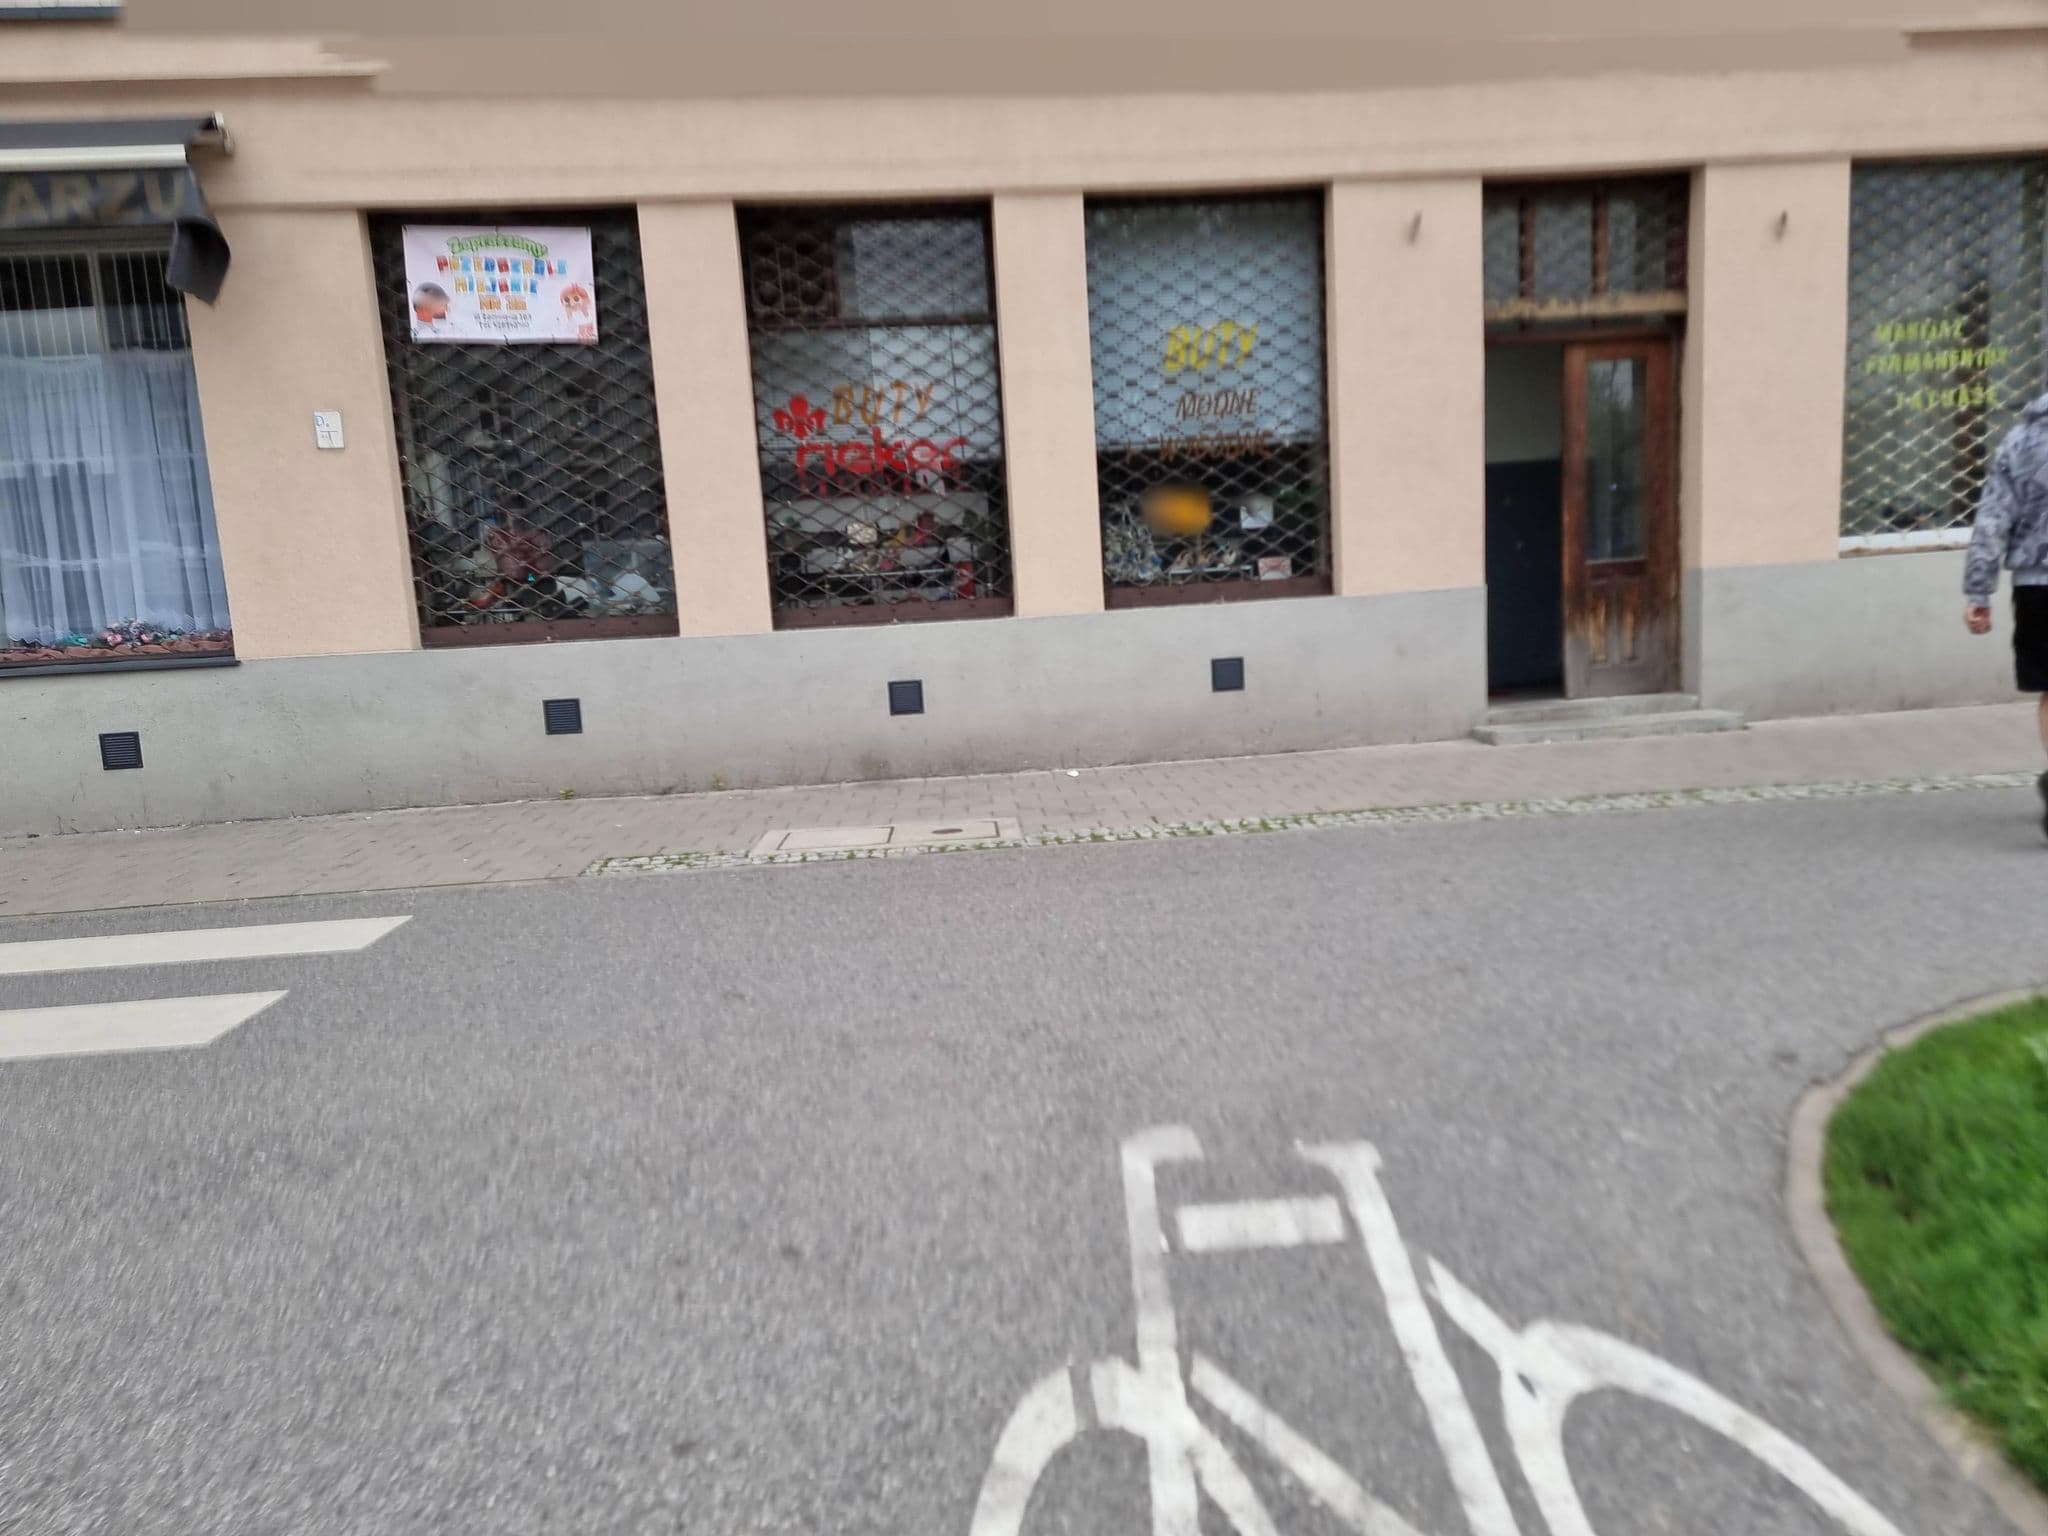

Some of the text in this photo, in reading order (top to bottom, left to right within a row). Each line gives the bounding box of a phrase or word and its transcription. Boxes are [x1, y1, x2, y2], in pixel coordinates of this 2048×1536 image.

[1165, 319, 1258, 372] BUTY
[832, 379, 934, 425] BUTY
[796, 426, 968, 476] rieker
